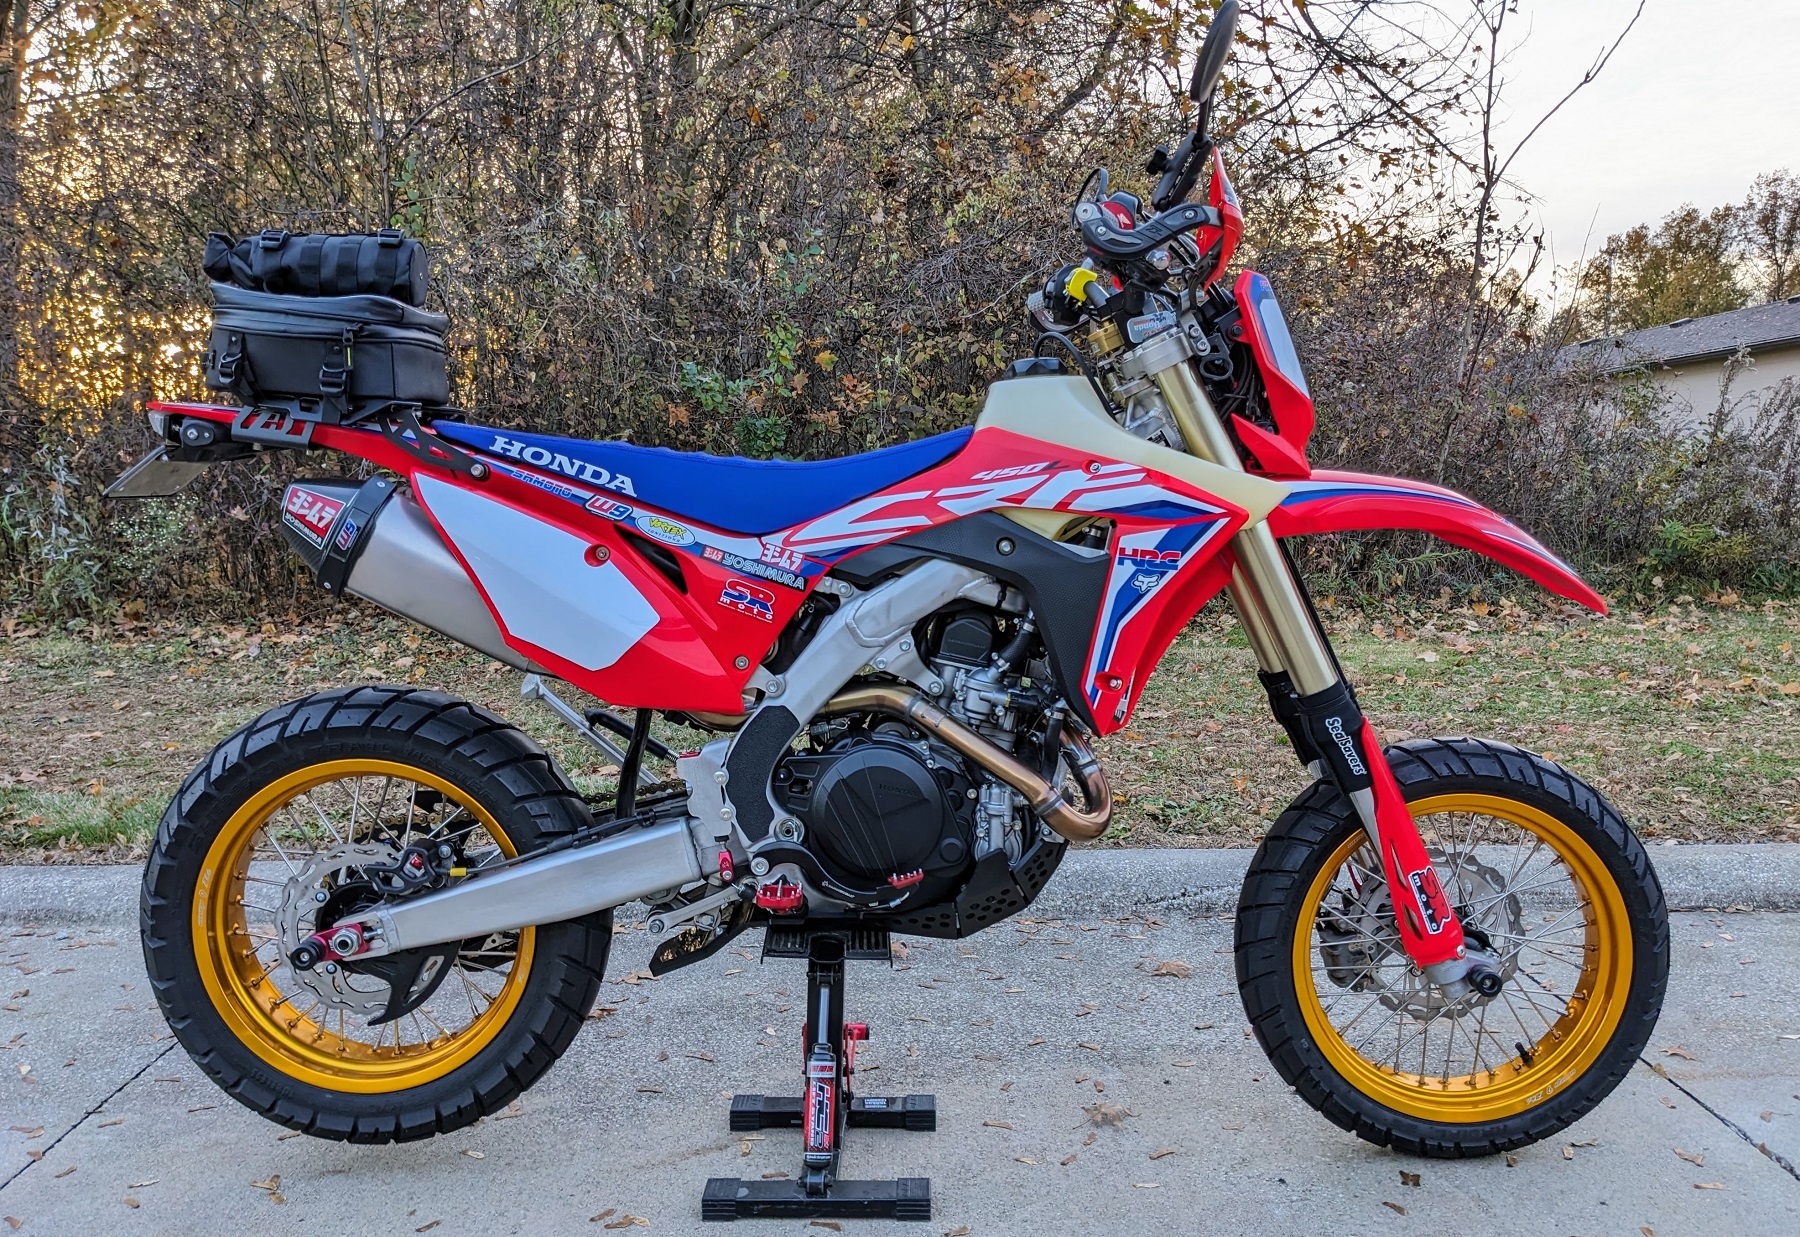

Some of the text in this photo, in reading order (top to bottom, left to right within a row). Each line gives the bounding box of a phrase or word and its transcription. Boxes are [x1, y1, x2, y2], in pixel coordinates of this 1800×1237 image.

[489, 435, 638, 498] HONDA
[287, 491, 336, 529] ヨシムラ
[588, 496, 631, 518] W9
[285, 512, 323, 545] YOSHIMURA
[648, 517, 688, 540] VORTEX
[722, 553, 805, 591] YOSHIMURA
[762, 543, 804, 572] ヨシムラ
[1117, 546, 1182, 571] HRC
[719, 596, 774, 620] moto
[722, 578, 775, 615] SR
[1413, 875, 1438, 931] moto
[1420, 867, 1451, 924] SR
